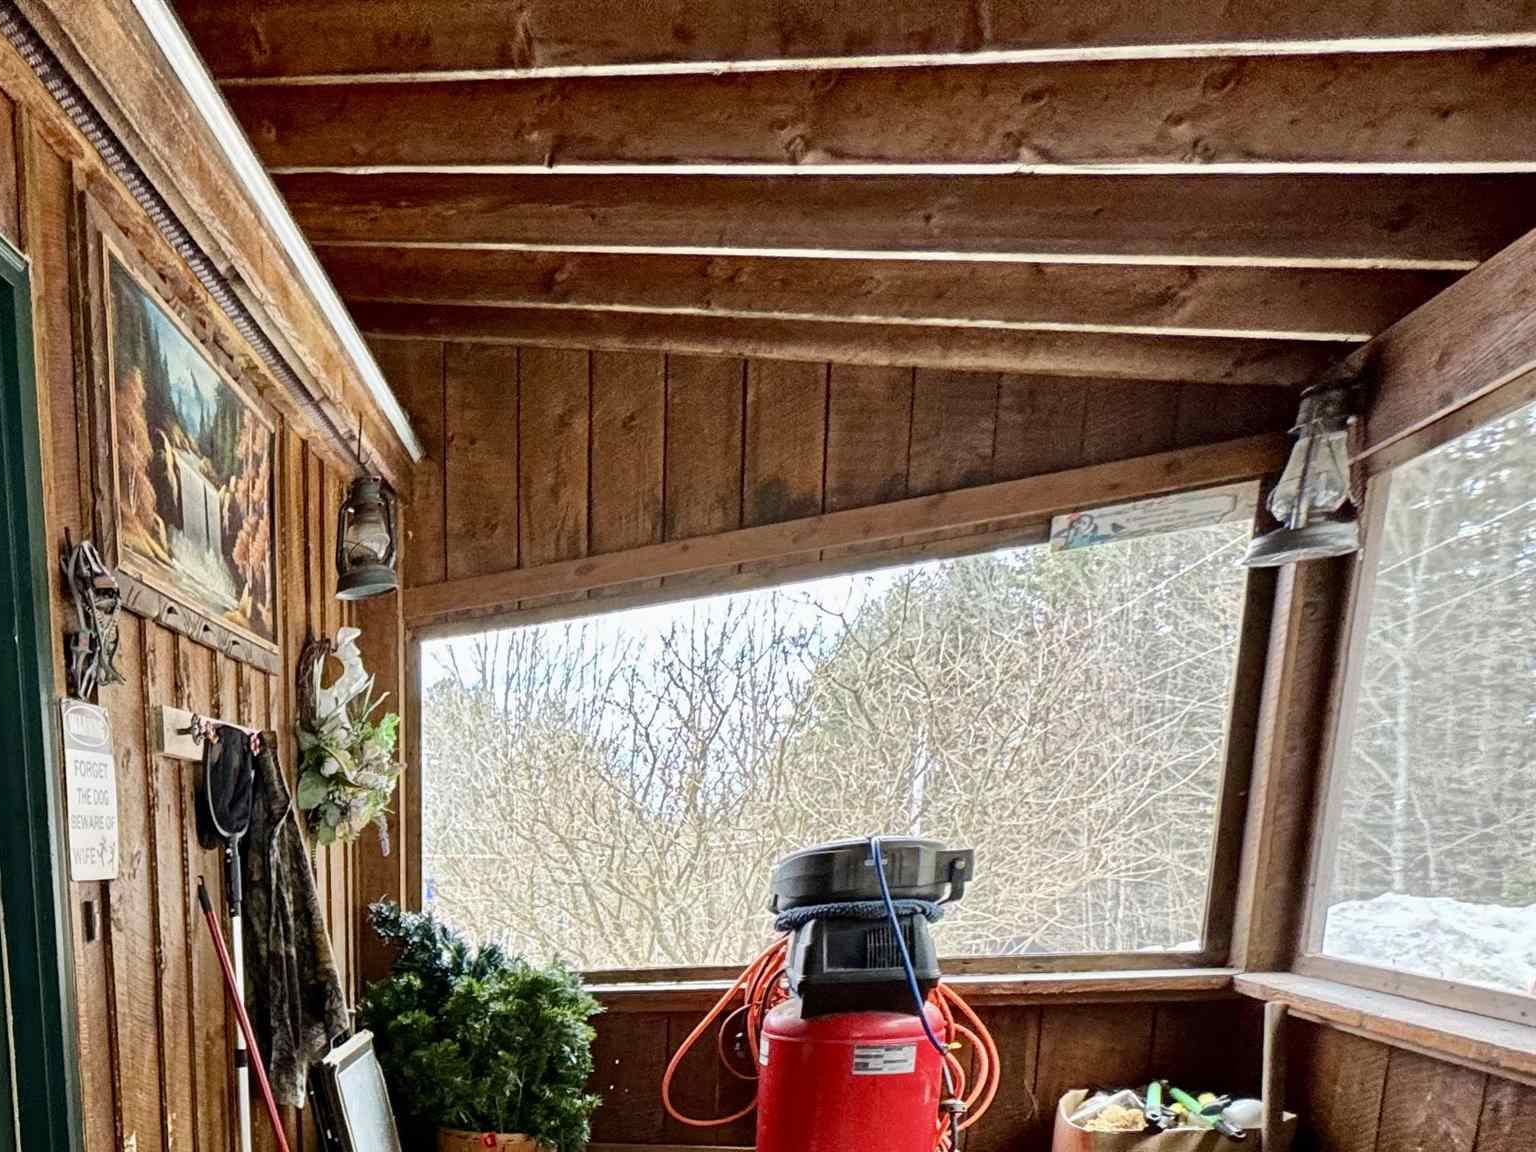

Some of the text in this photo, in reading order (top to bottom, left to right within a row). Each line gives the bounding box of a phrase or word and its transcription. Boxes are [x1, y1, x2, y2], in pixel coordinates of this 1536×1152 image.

[74, 759, 108, 778] FORGET
[76, 787, 110, 806] THE DOG
[71, 814, 116, 831] BEWARE OF
[72, 847, 96, 865] WIFE
